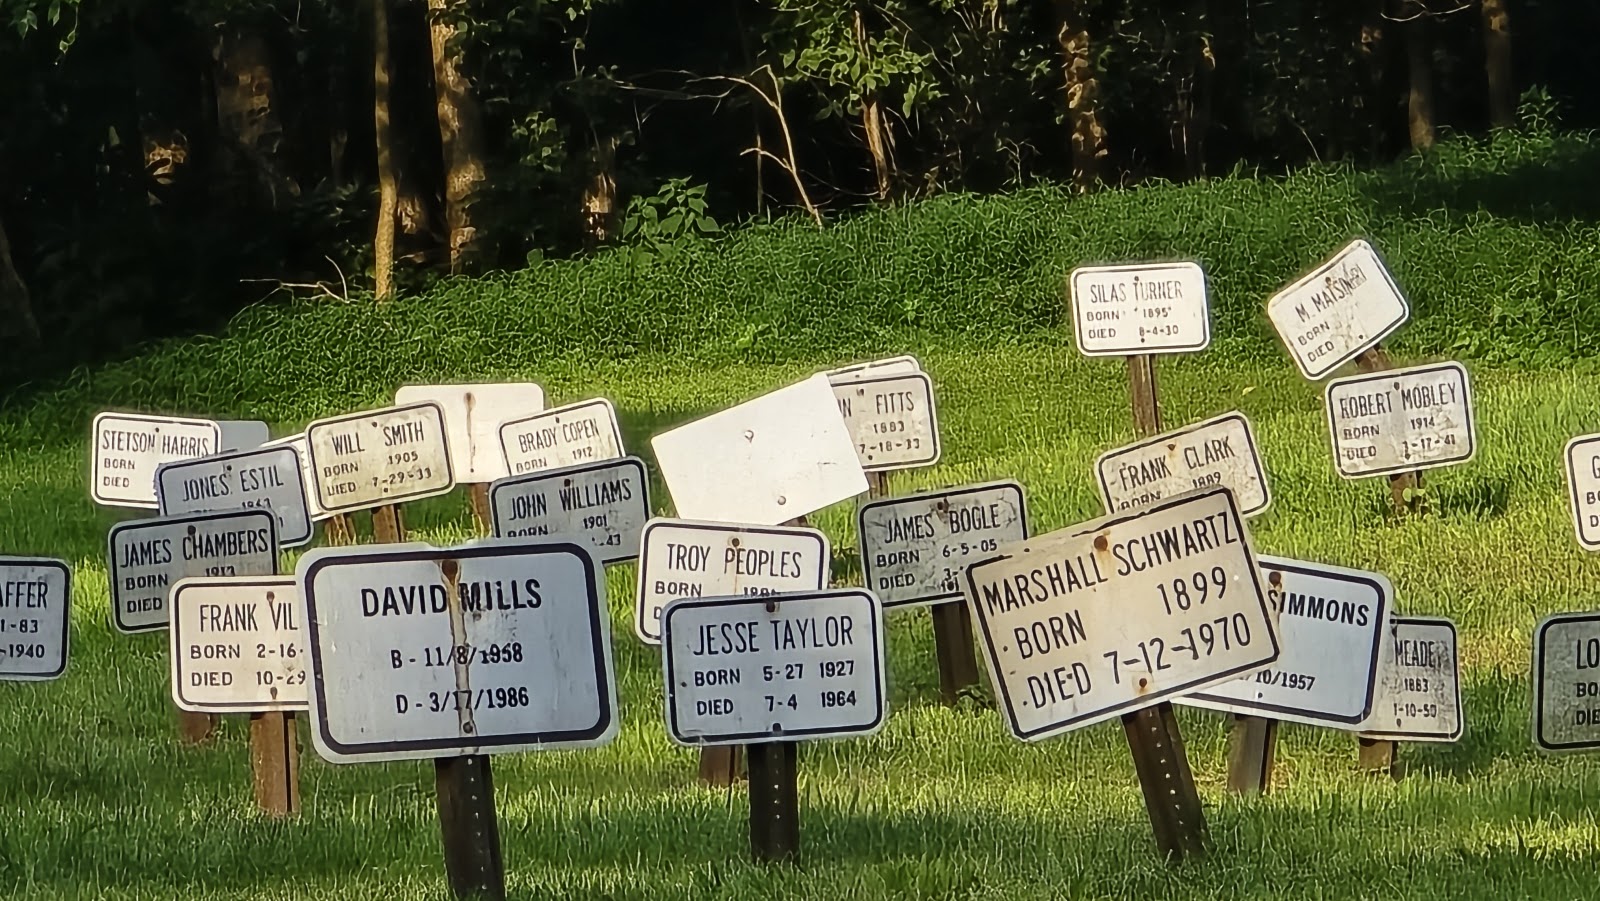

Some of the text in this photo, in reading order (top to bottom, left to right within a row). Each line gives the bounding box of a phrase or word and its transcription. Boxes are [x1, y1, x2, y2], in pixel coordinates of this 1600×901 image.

[1090, 280, 1182, 303] SILAS TURNER
[1087, 310, 1119, 321] BORN
[1088, 328, 1116, 338] DIED
[1298, 321, 1330, 346] BORN
[1308, 341, 1334, 362] DIED
[876, 391, 914, 414] FITTS
[1340, 382, 1456, 419] ROBERT MOBLEY
[332, 421, 425, 456] WILL SMITH
[518, 418, 600, 454] BRADY COPEN
[1343, 415, 1435, 440] BORN 1914
[102, 429, 209, 459] STETSON HARRIS
[1346, 445, 1377, 460] DIED
[104, 458, 136, 470] BORN
[324, 451, 419, 478] BORN 1905
[516, 446, 593, 473] BORN 1912
[1119, 435, 1236, 492] FRANK CLARK
[103, 476, 130, 487] DIED
[239, 465, 284, 492] ESTIL
[327, 482, 356, 496] DIED
[509, 478, 632, 520] JOHN WILLIAMS
[583, 513, 607, 529] 1901
[885, 504, 1000, 544] JAMES BOGLE
[120, 528, 268, 568] JAMES CHAMBERS
[667, 543, 802, 578] TROY PEOPLES
[877, 539, 997, 567] BORN 6-5-05
[982, 511, 1237, 617] MARSHALL SCHWARTZ
[126, 573, 168, 591] BORN
[655, 581, 702, 597] BORN
[879, 573, 916, 589] DIED
[1156, 566, 1227, 615] 1899
[127, 597, 163, 613] DIED
[361, 578, 542, 617] DAVID MILLS
[1267, 589, 1370, 627] SIMMONS
[200, 602, 298, 632] FRANK VIL
[693, 615, 854, 656] JESSE TAYLOR
[1014, 609, 1087, 659] BORN
[190, 643, 240, 659] BORN
[1027, 612, 1251, 709] DIED 7-12-1970
[191, 670, 306, 687] DIED 10-29
[694, 668, 741, 687] BORN
[819, 660, 855, 679] 1927
[1246, 668, 1316, 692] 10/1957
[697, 690, 857, 716] DIED 7-4 1964
[1576, 682, 1600, 698] BO
